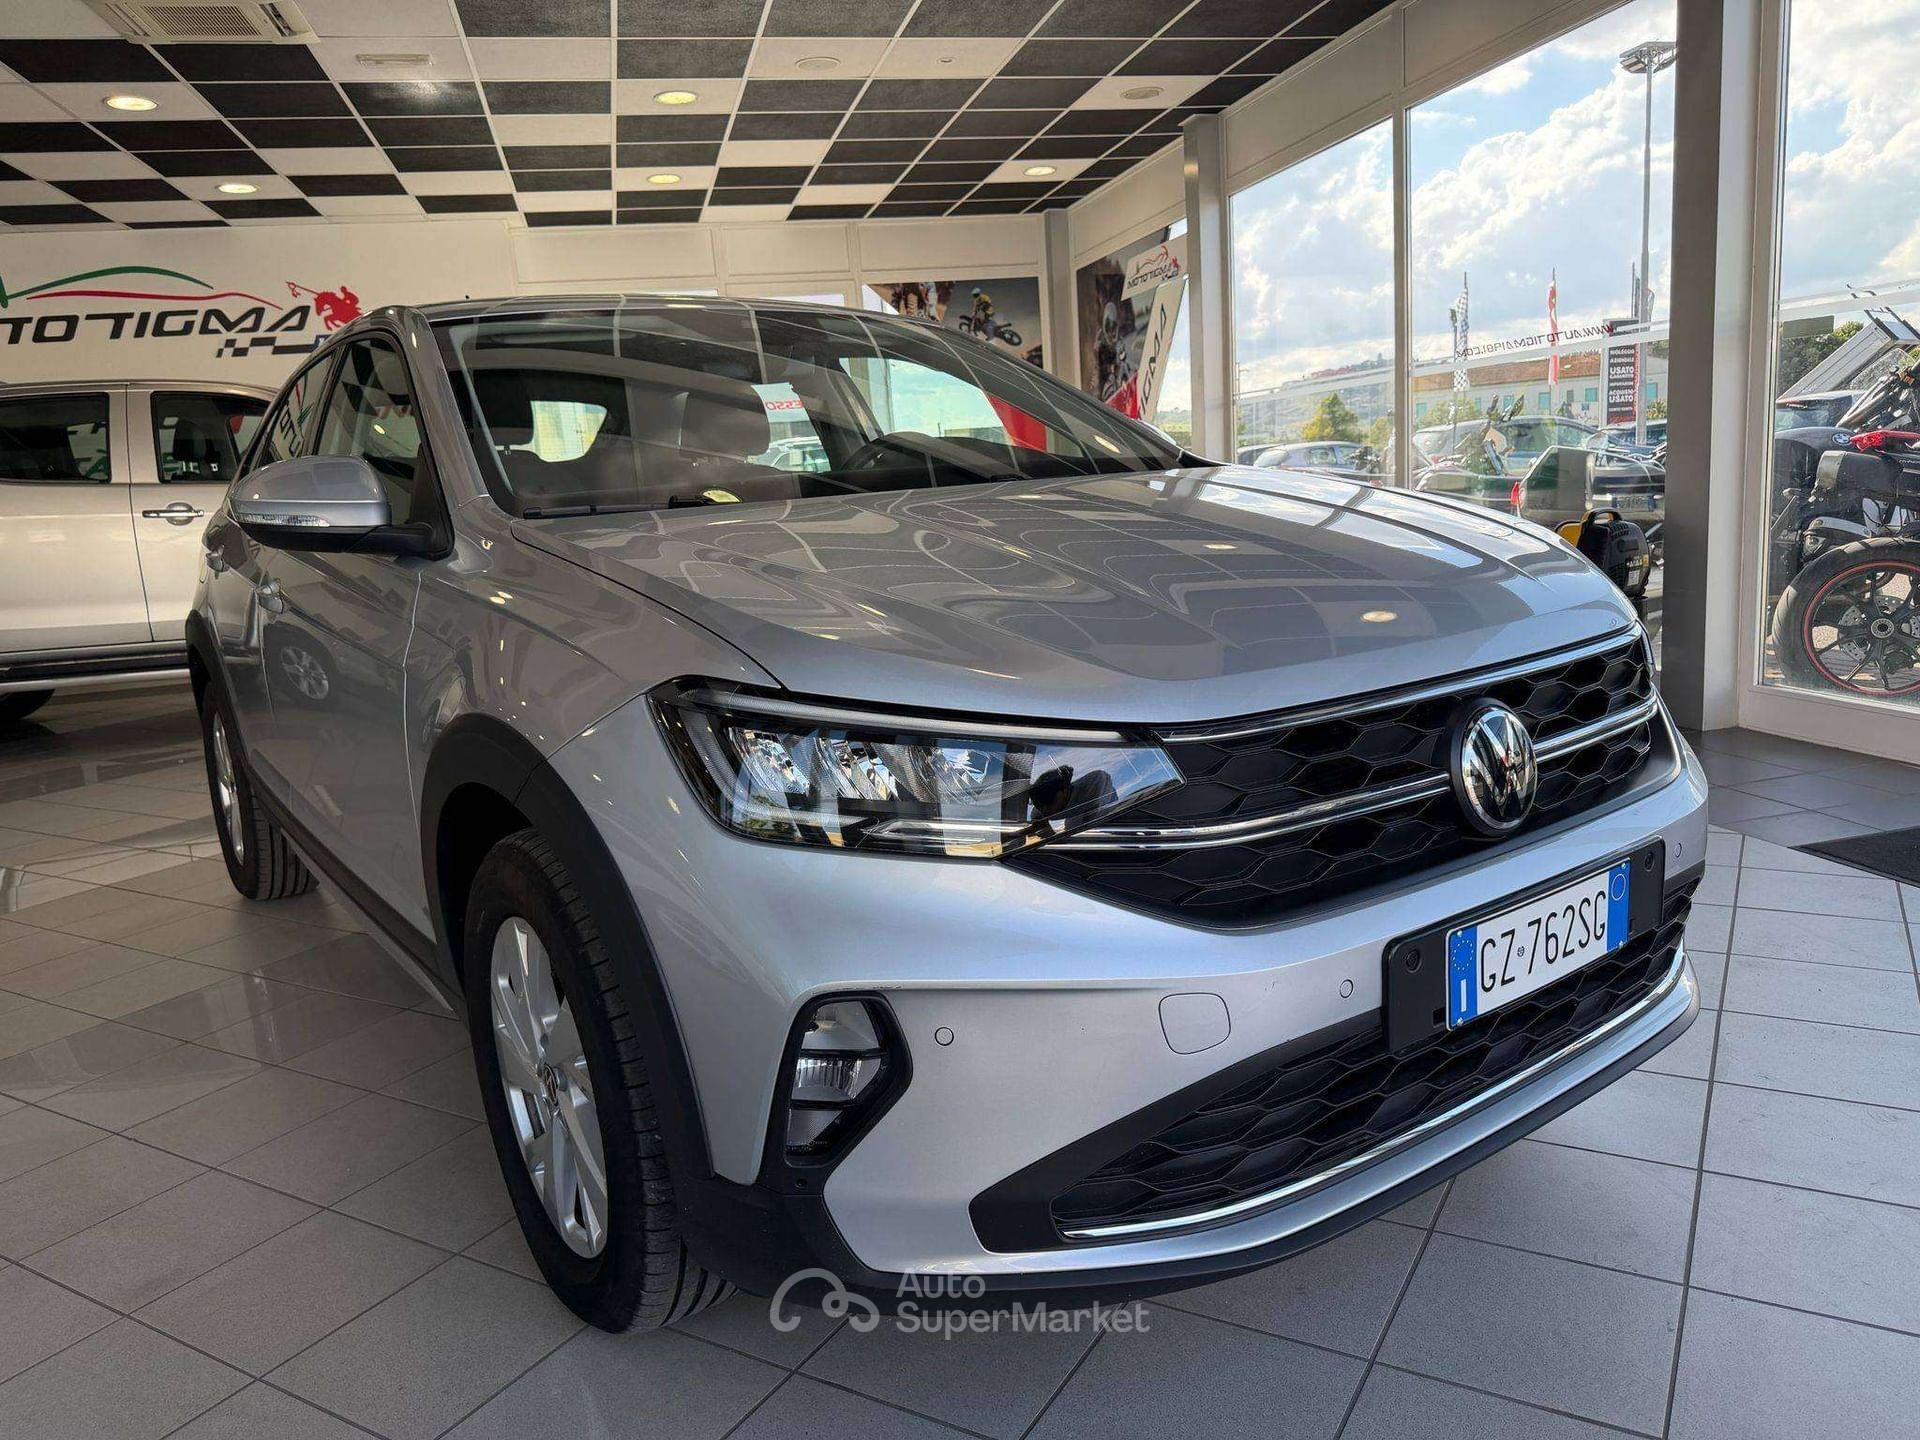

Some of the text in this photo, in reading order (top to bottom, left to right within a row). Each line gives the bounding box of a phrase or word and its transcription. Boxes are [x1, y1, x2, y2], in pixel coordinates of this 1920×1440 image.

[84, 305, 311, 340] TIGMA
[1609, 366, 1634, 374] USATO
[1609, 395, 1633, 403] USATO
